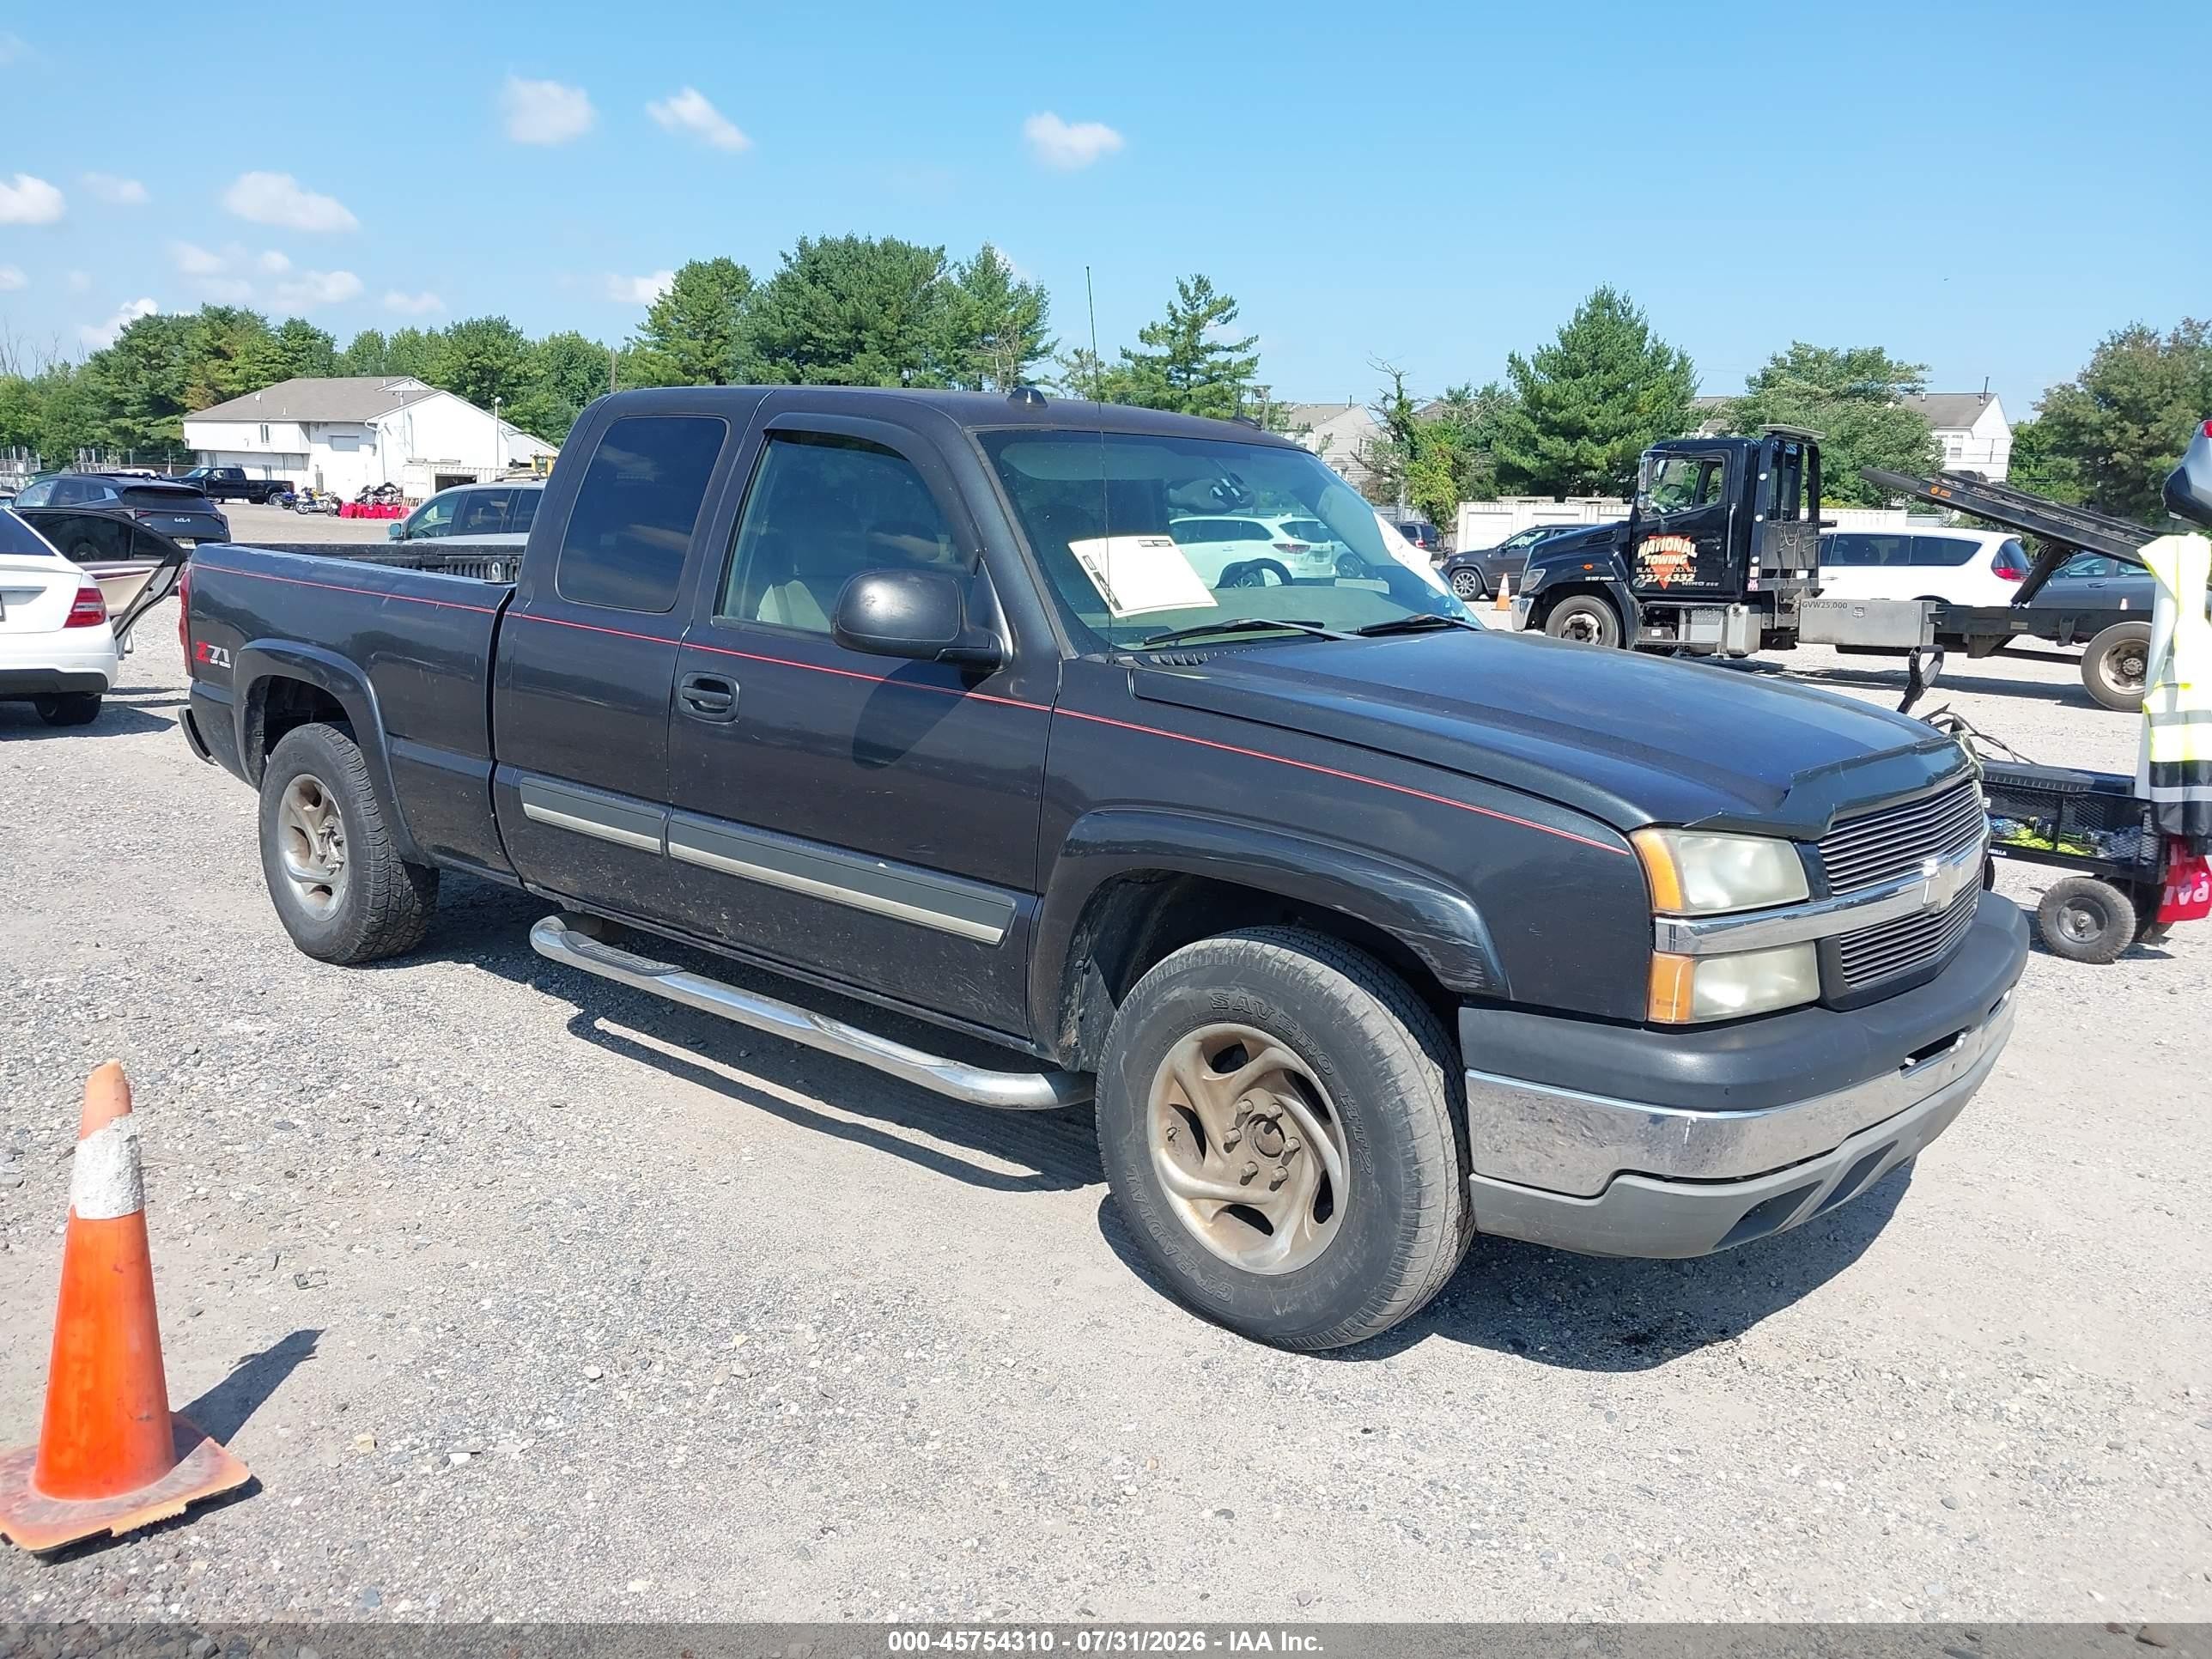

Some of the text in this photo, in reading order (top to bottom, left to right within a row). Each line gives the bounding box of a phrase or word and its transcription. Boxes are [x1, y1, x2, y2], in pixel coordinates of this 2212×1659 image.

[1638, 537, 1698, 559] NATIONAL
[1644, 554, 1688, 565] TOWING
[196, 641, 230, 664] Z71
[1208, 992, 1335, 1075] SAVERO
[1339, 1090, 1374, 1176] HT2
[1126, 1164, 1235, 1304] GT RADIAL
